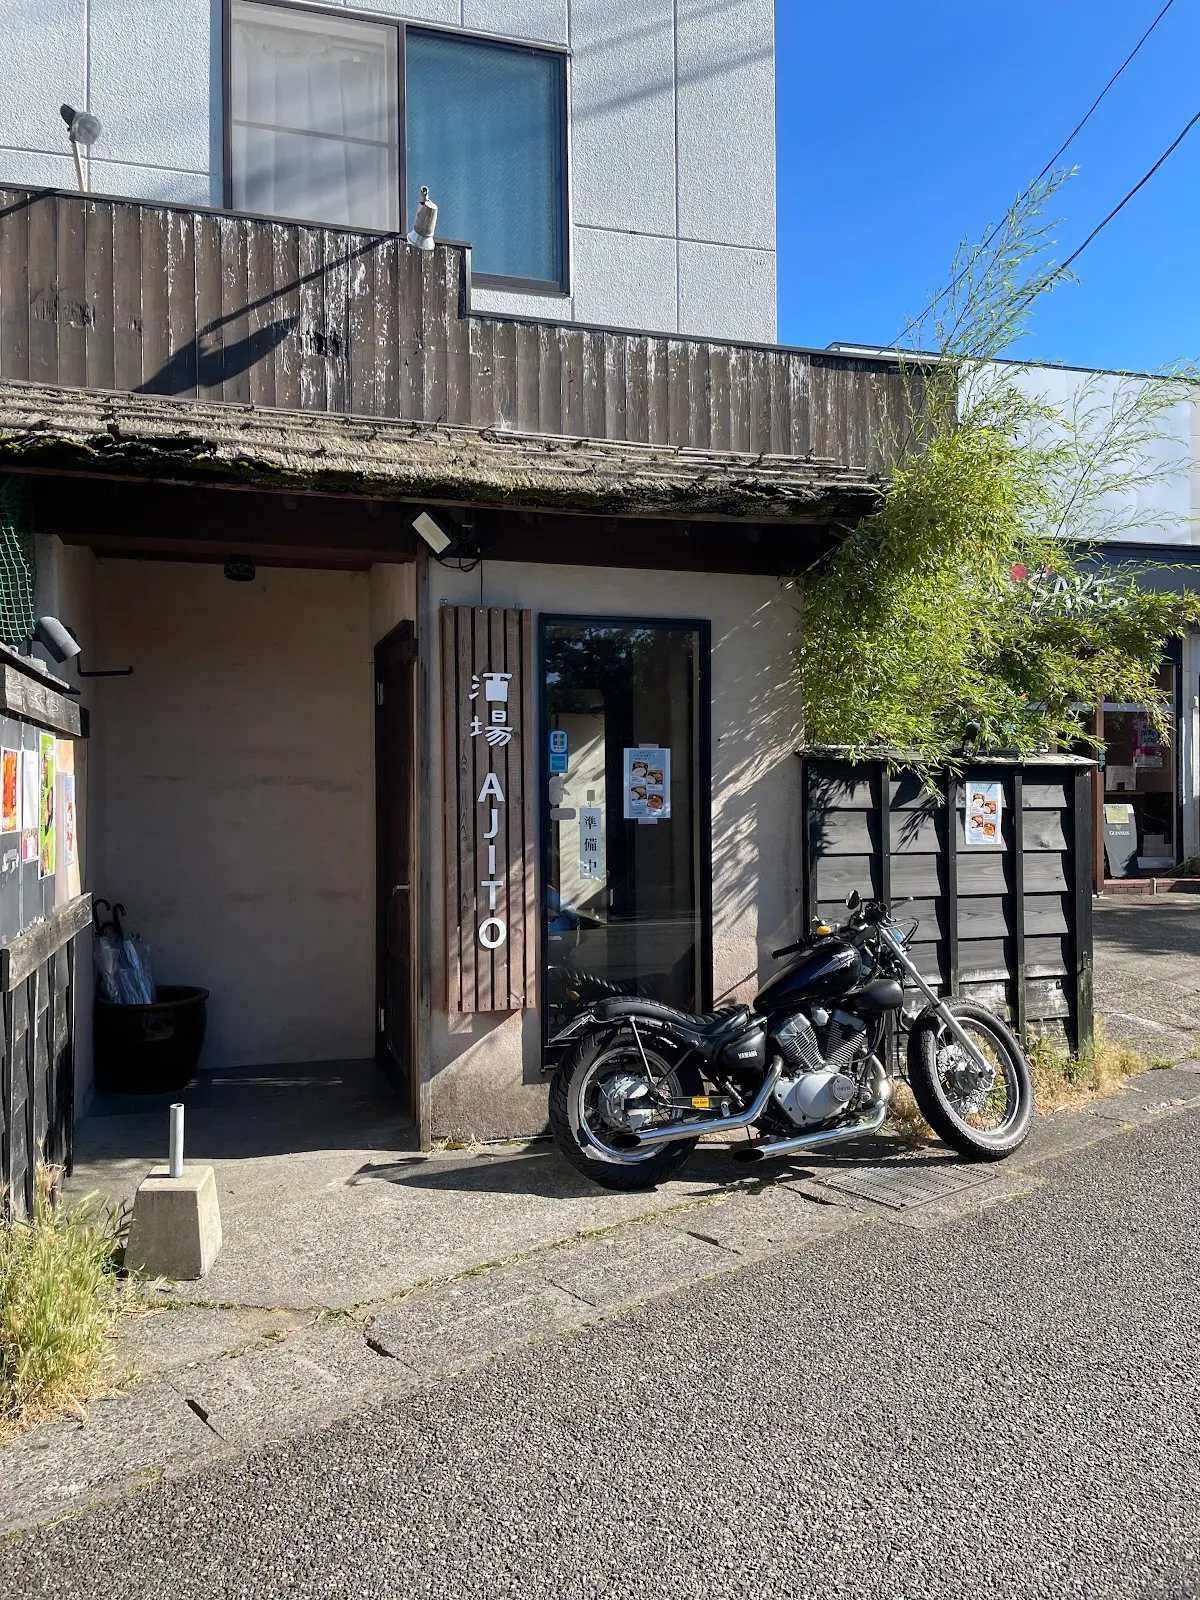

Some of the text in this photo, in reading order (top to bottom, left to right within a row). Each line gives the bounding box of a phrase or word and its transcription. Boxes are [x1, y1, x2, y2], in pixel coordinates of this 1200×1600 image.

[468, 672, 514, 949] 酒場 AJITO
[584, 815, 597, 873] 準備中
[737, 1050, 758, 1060] YAMAHA
